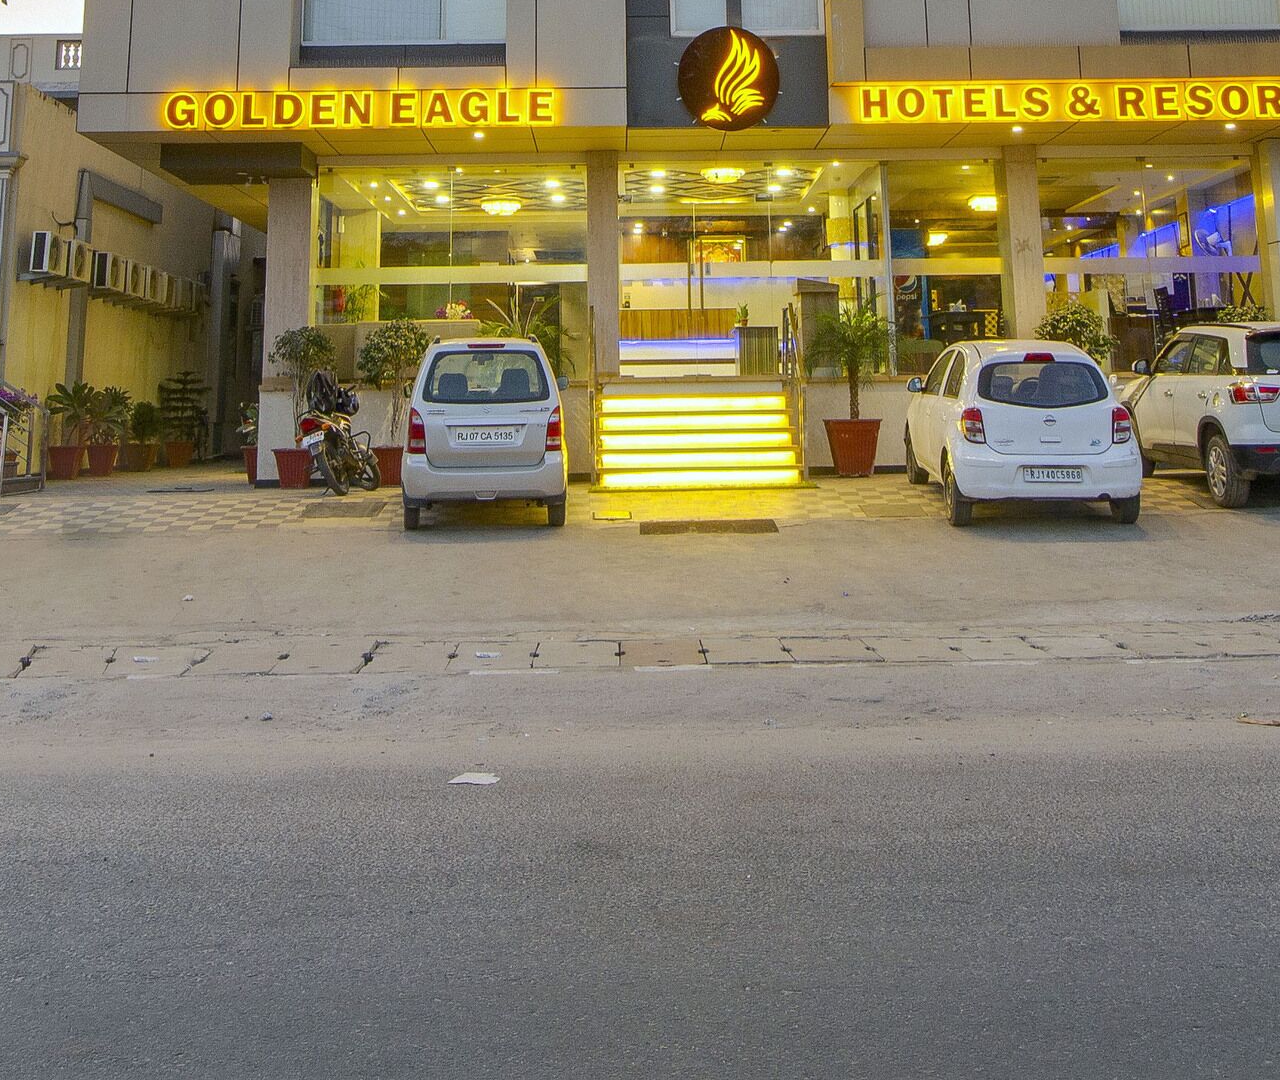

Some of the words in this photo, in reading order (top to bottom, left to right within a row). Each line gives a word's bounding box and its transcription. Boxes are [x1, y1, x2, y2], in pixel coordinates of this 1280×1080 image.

[165, 89, 375, 129] GOLDEN
[388, 87, 555, 127] EAGLE
[859, 84, 1052, 122] HOTELS
[1064, 83, 1102, 120] &
[896, 292, 917, 301] pepsi
[457, 431, 468, 440] RJ
[469, 431, 479, 440] 07
[480, 431, 492, 440] CA
[494, 431, 513, 440] 5135
